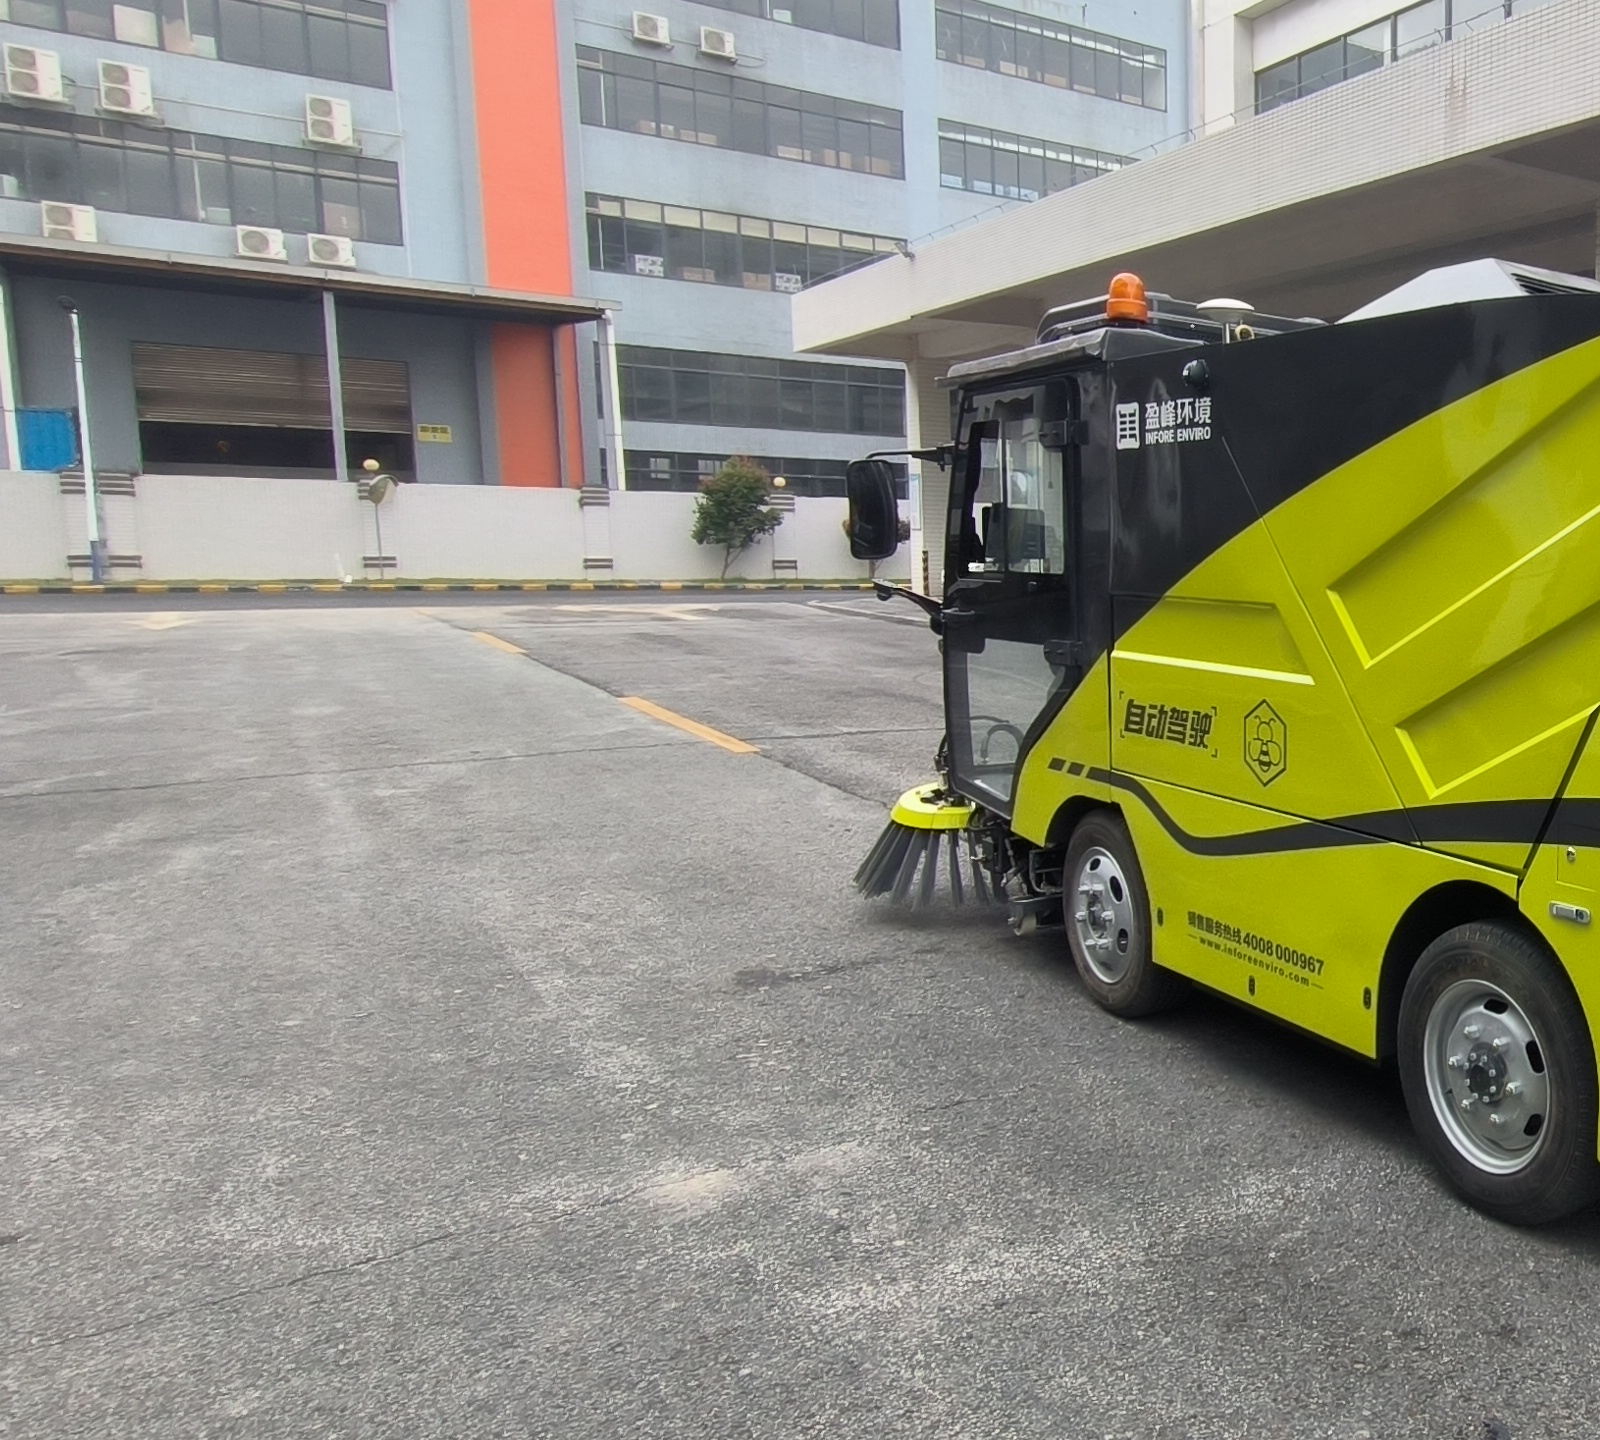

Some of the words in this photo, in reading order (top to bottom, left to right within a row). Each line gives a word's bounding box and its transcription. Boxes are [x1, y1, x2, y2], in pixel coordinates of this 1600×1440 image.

[1145, 397, 1212, 429] 盈峰环境
[1145, 429, 1175, 446] INFORE
[1177, 426, 1211, 442] ENVIRO
[1124, 699, 1213, 749] 自动驾驶
[1199, 936, 1310, 986] www.inforeenviro.com
